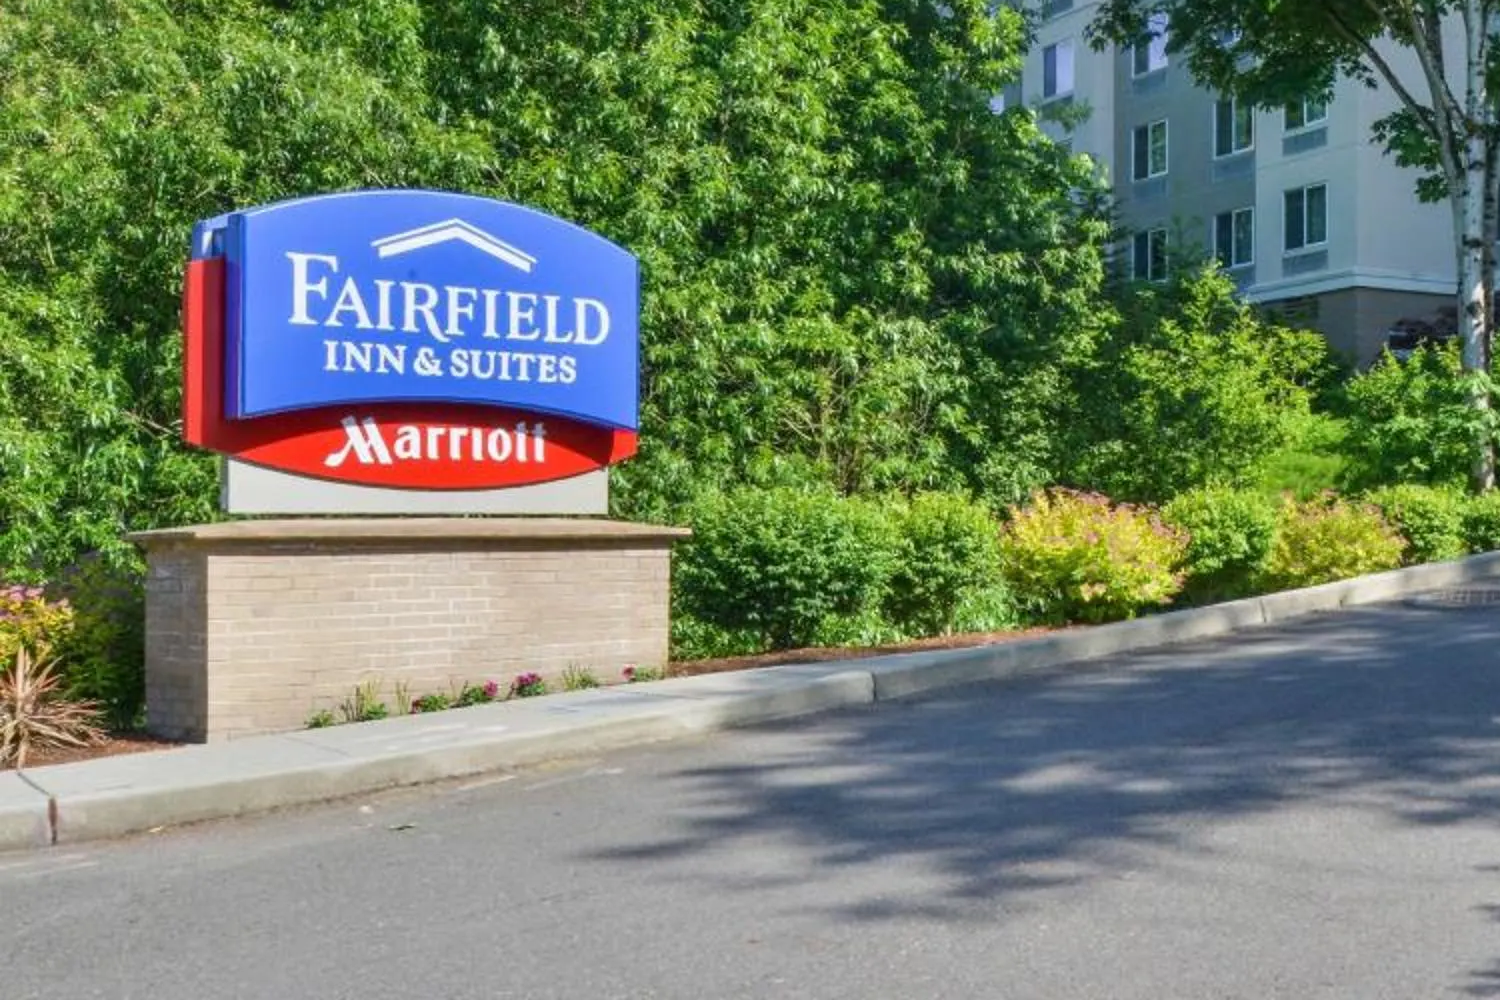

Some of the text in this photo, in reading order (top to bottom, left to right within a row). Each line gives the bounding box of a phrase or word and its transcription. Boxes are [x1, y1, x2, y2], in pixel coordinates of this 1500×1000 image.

[286, 251, 611, 346] FAIRFIELD
[323, 340, 577, 384] INN & SUITES
[323, 416, 547, 468] Marriott
